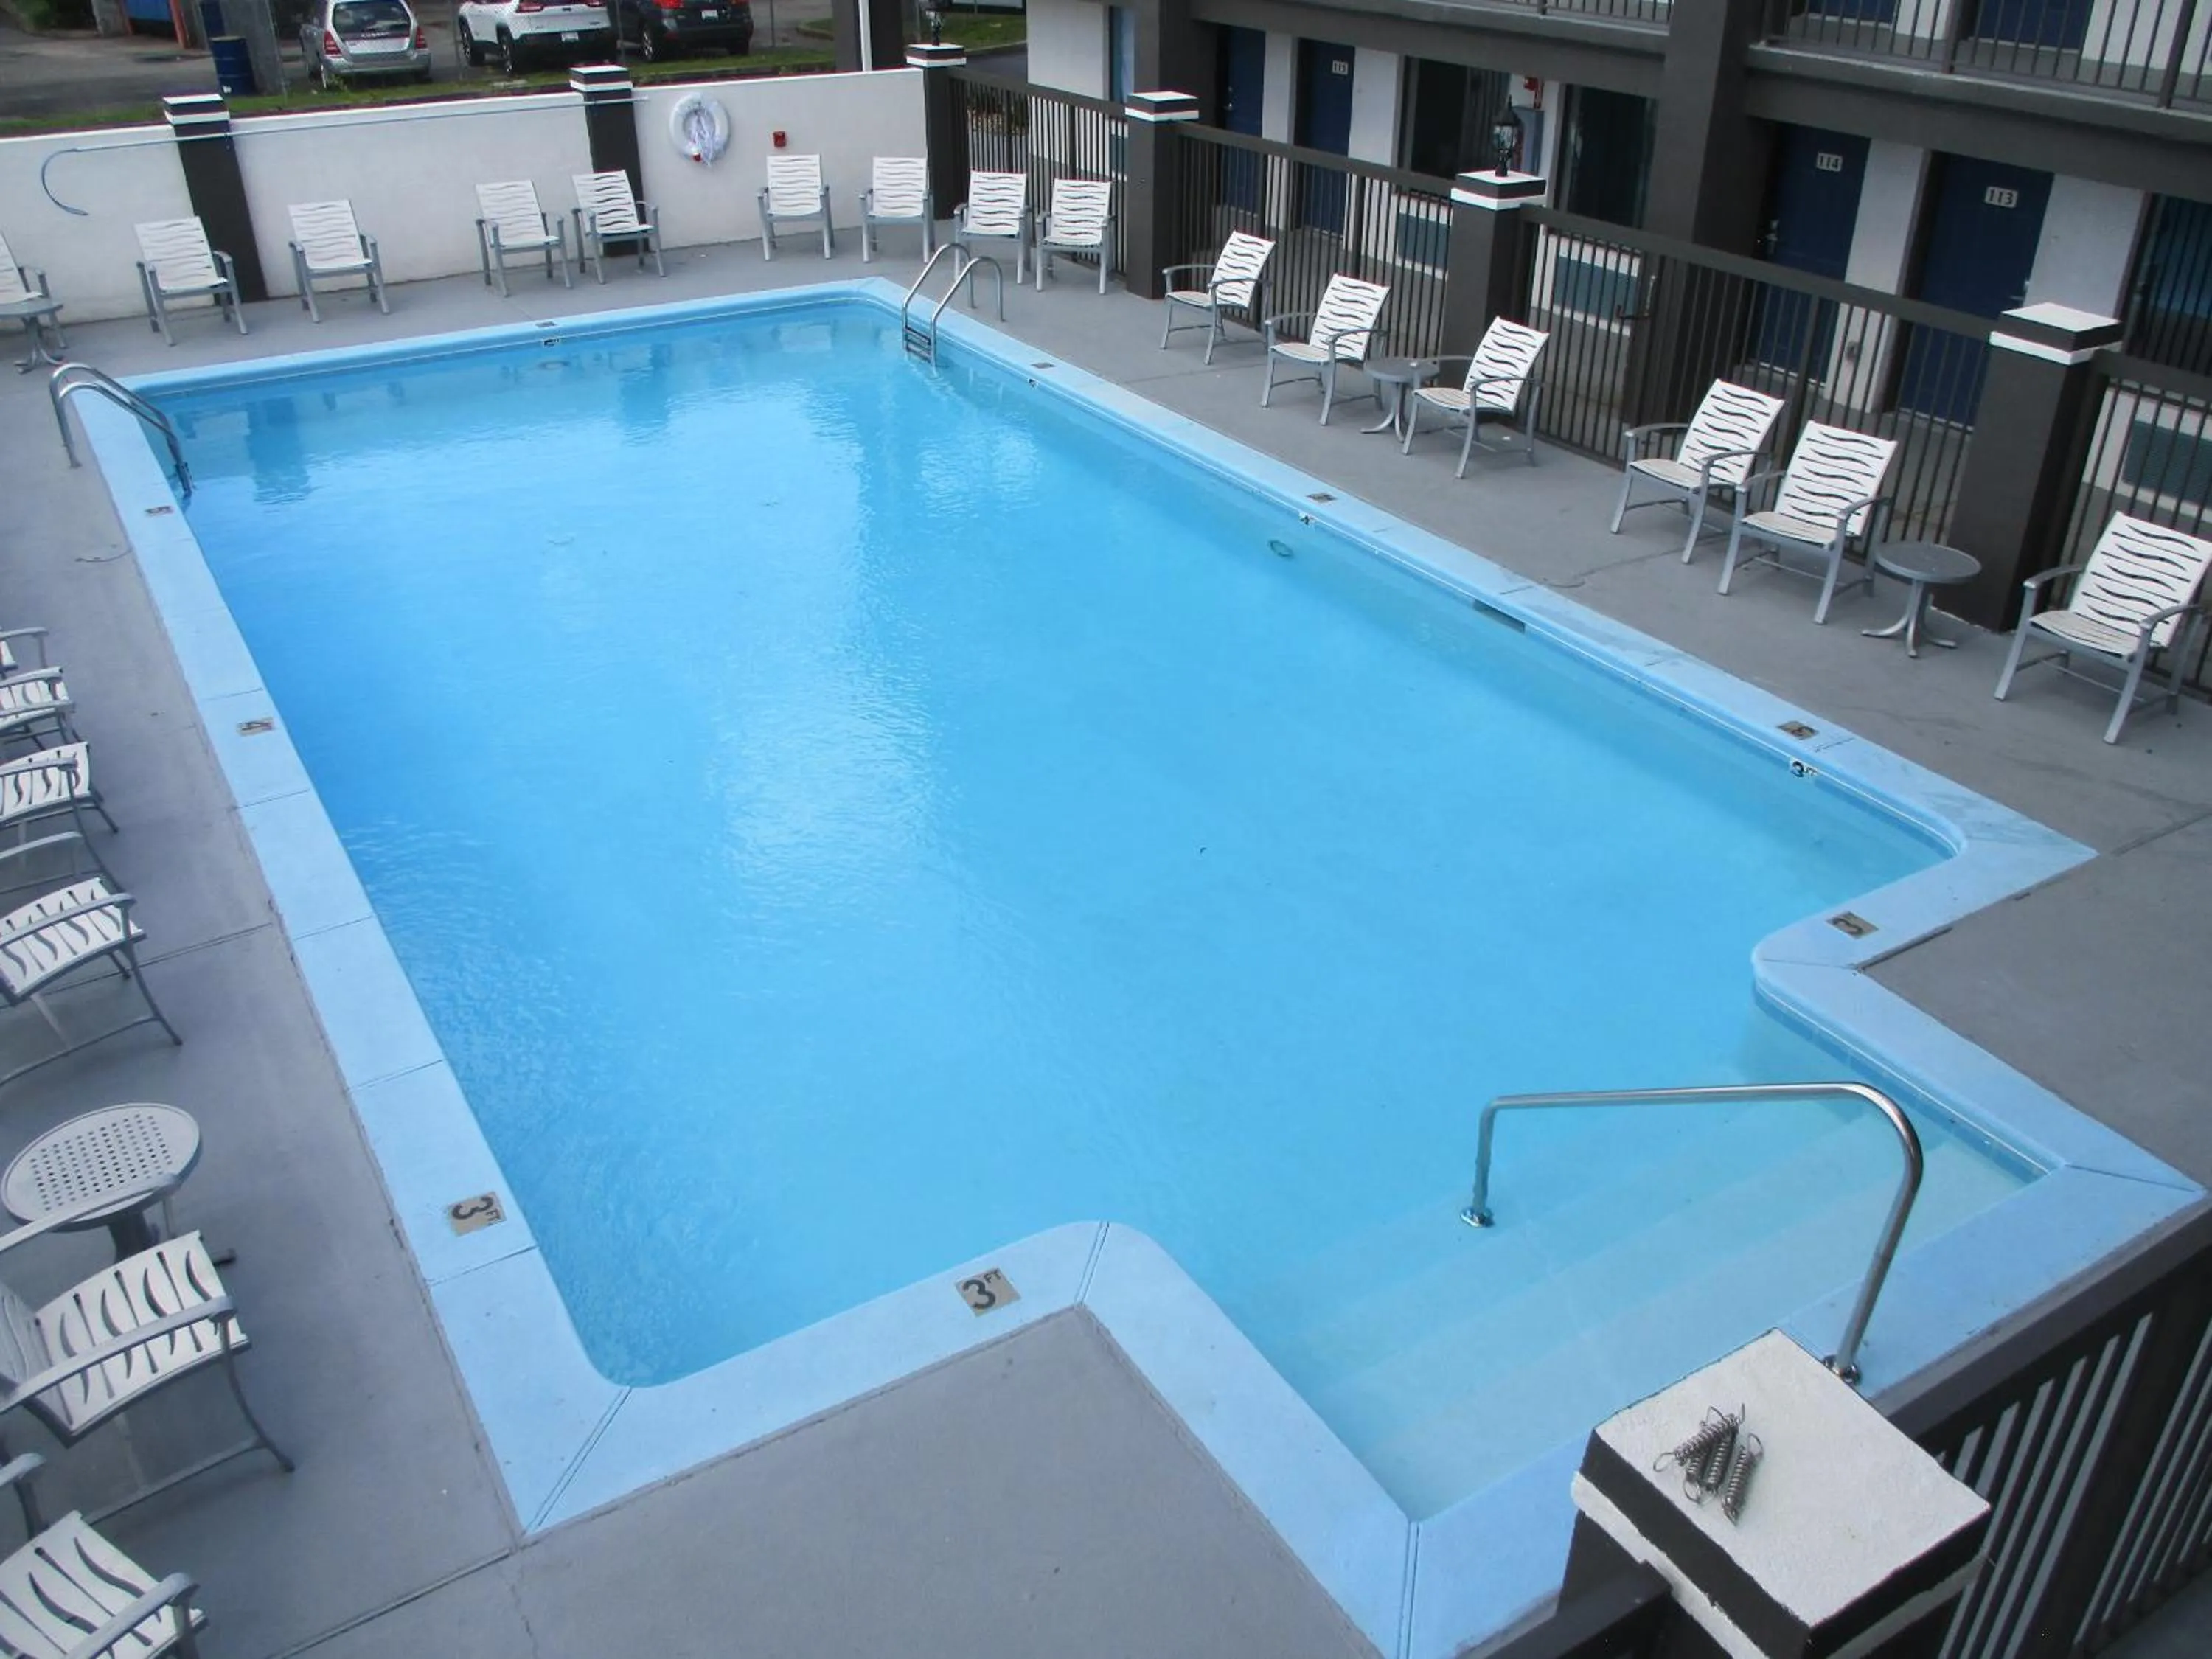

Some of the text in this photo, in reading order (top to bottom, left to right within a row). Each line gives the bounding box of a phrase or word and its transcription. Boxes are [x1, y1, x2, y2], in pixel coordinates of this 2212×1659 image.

[1989, 188, 2014, 205] 113
[1790, 760, 1804, 778] 3
[451, 1195, 494, 1220] 3
[961, 1269, 1001, 1310] 3 FT
